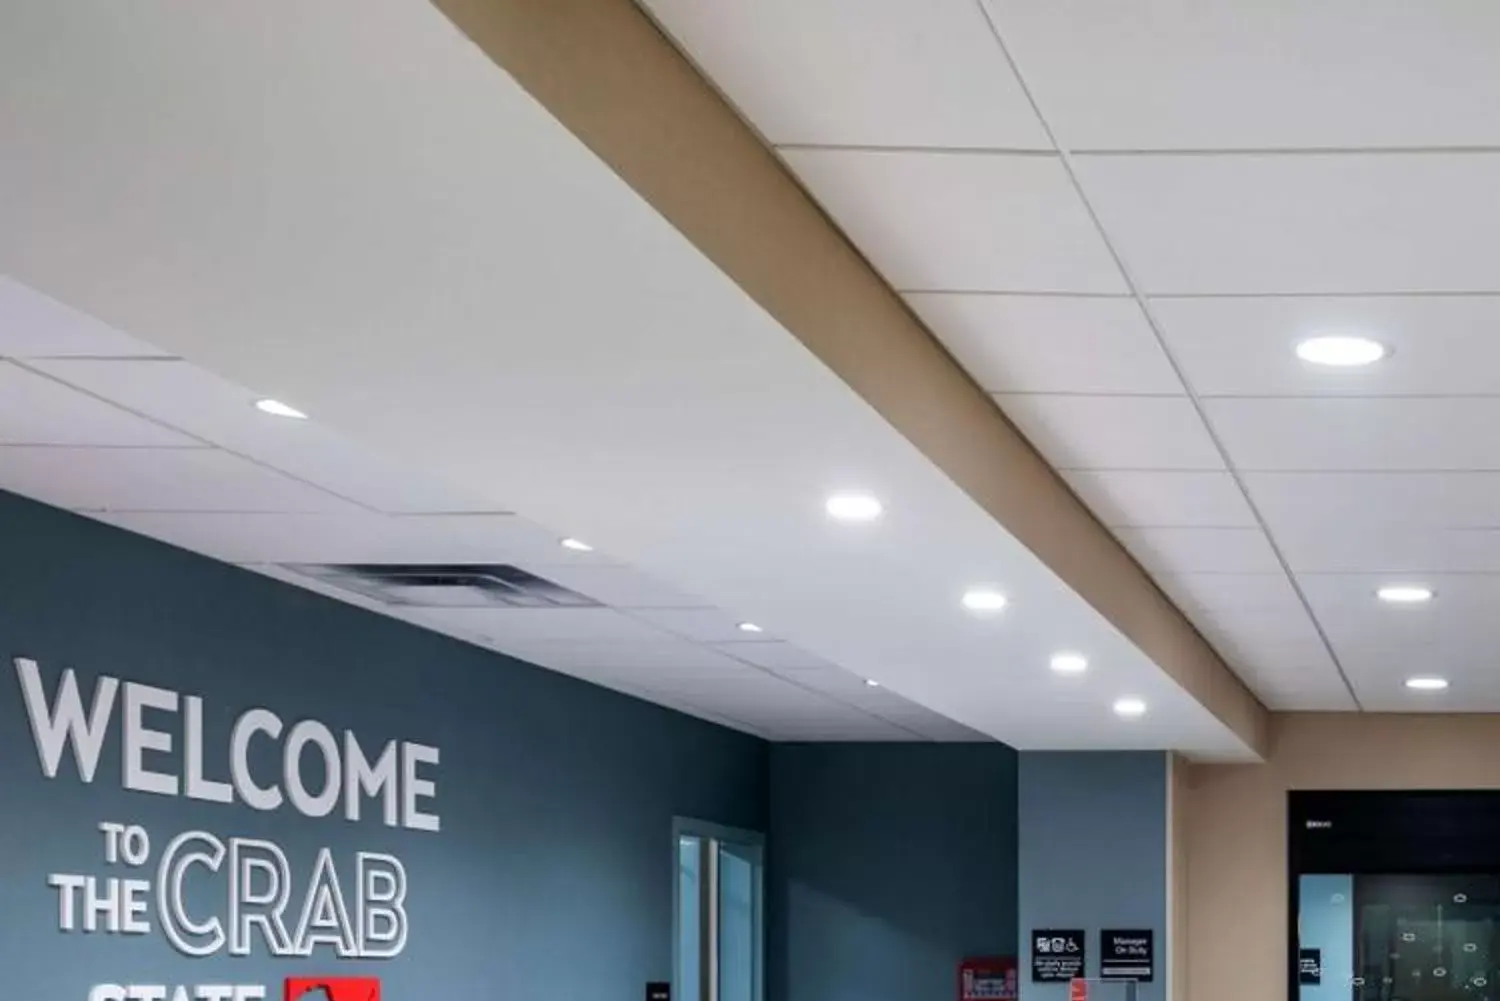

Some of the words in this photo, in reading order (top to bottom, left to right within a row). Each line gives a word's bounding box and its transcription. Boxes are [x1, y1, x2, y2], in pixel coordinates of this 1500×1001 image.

[14, 657, 440, 831] WELCOME
[48, 873, 151, 934] THE
[157, 830, 407, 958] CRAB
[100, 821, 150, 865] TO
